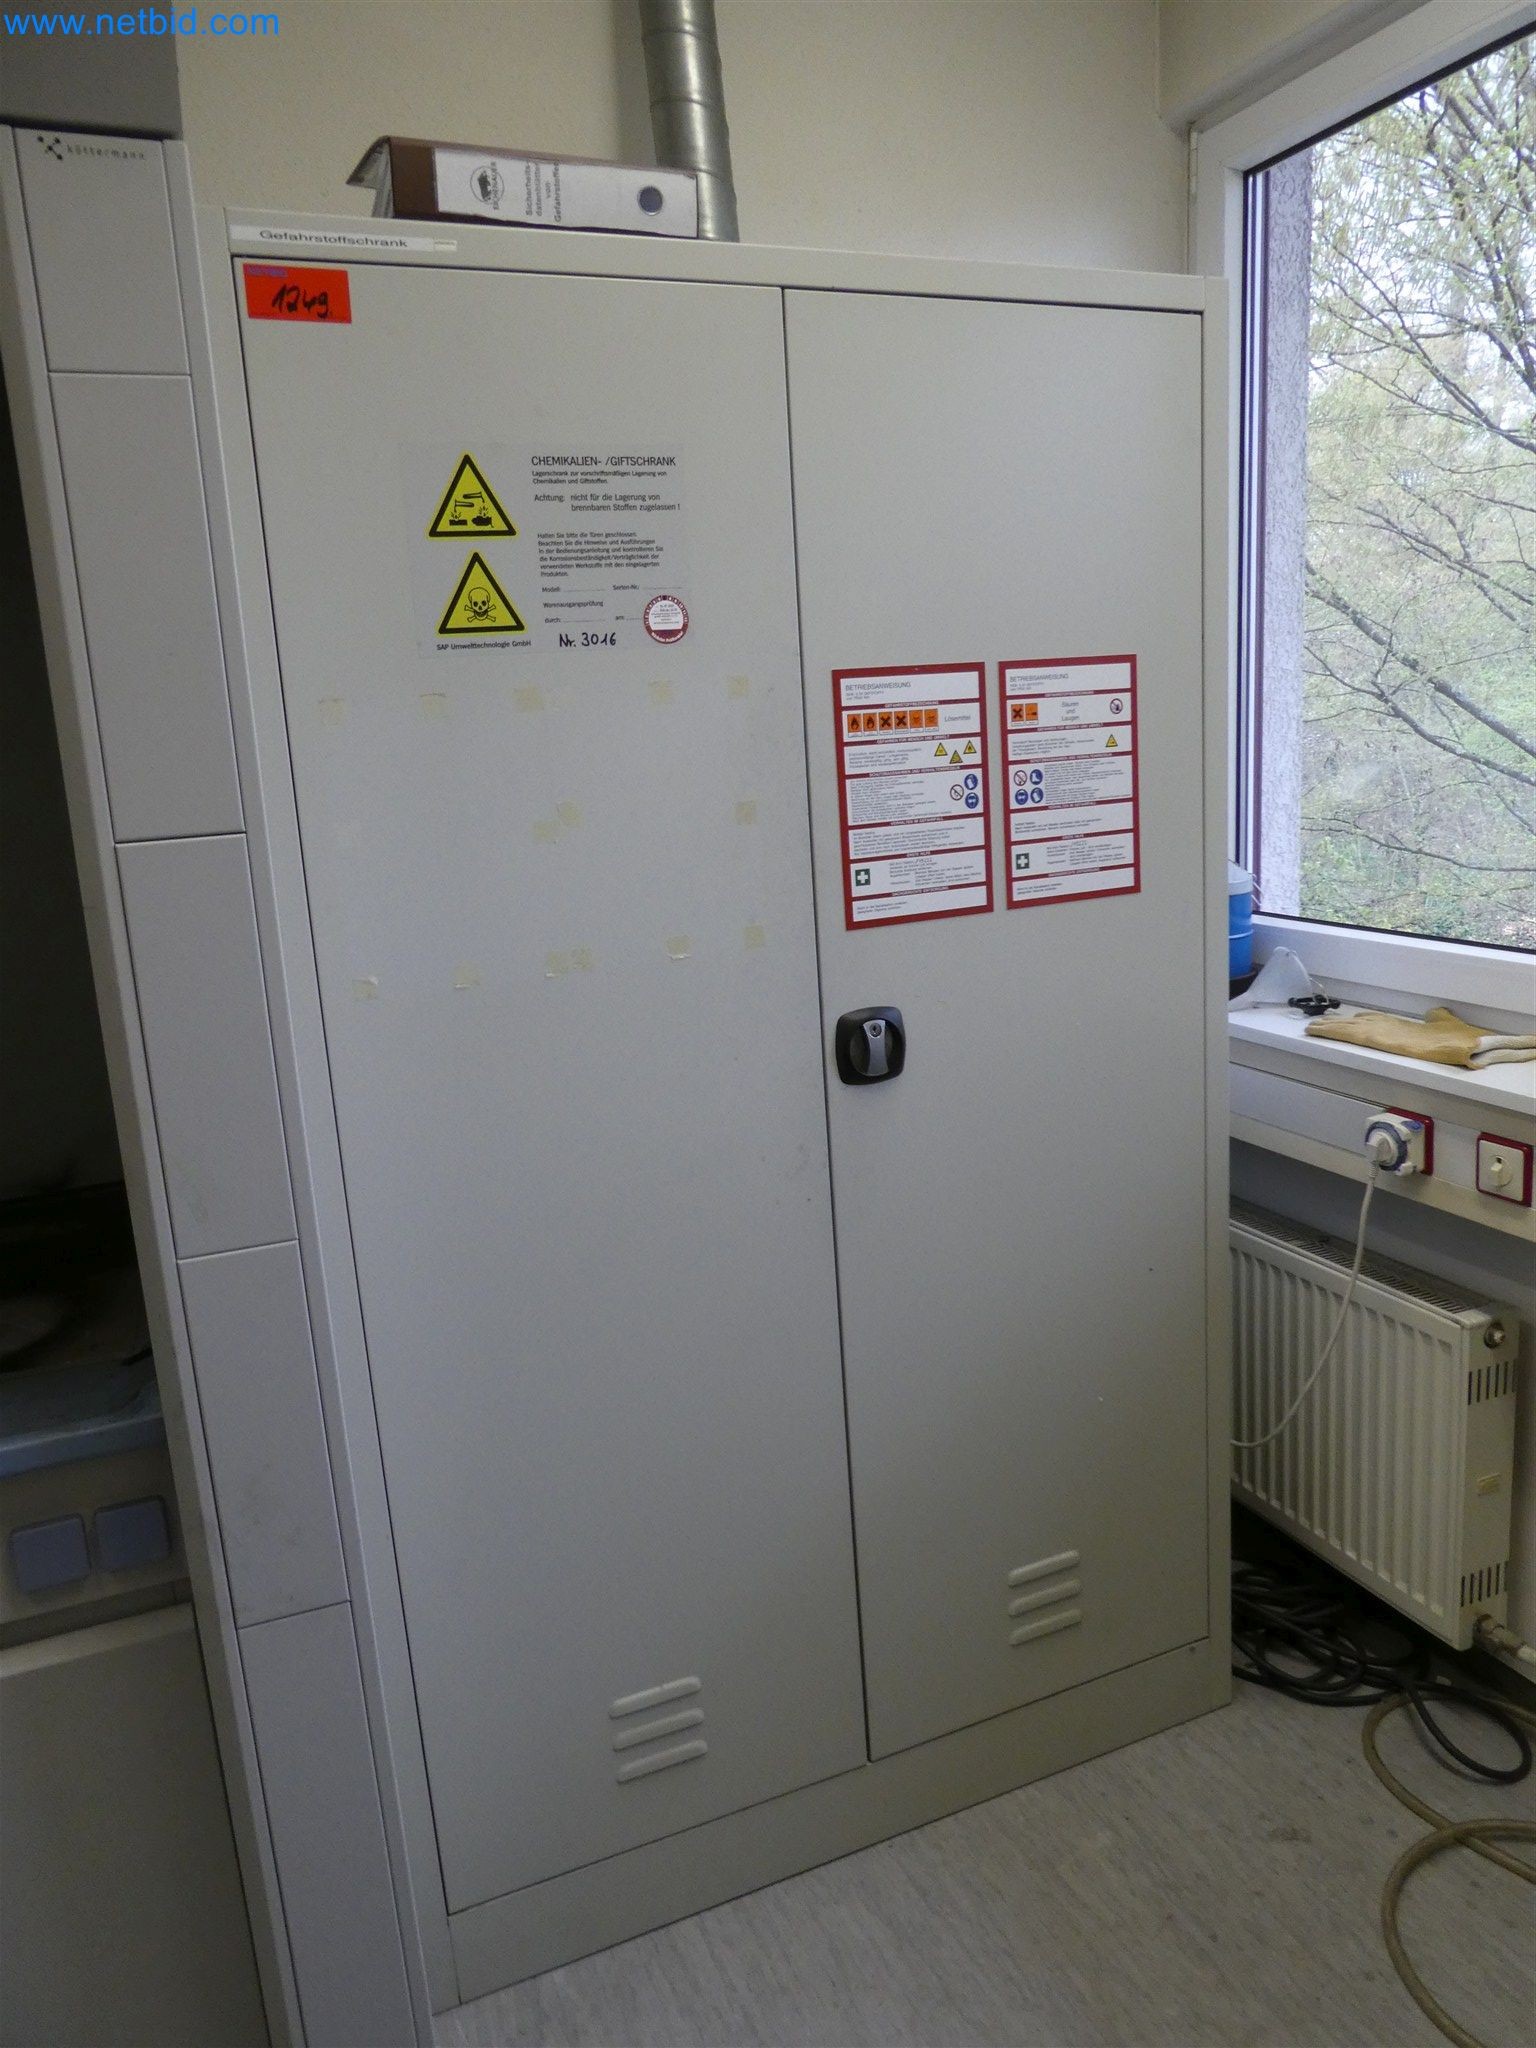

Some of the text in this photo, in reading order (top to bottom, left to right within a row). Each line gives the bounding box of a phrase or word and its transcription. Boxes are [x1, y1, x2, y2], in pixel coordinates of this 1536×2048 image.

[260, 230, 408, 247] Gefahrstoffschrank
[532, 456, 676, 466] CHEMIKALIEN- /GIFTSCHRANK
[614, 494, 646, 502] Lagerung
[640, 503, 676, 512] zugelassen
[559, 632, 617, 647] Nr. 3016
[451, 642, 510, 650] Umwelttechnologie
[846, 682, 912, 691] BETRIEBSANWEISUNG
